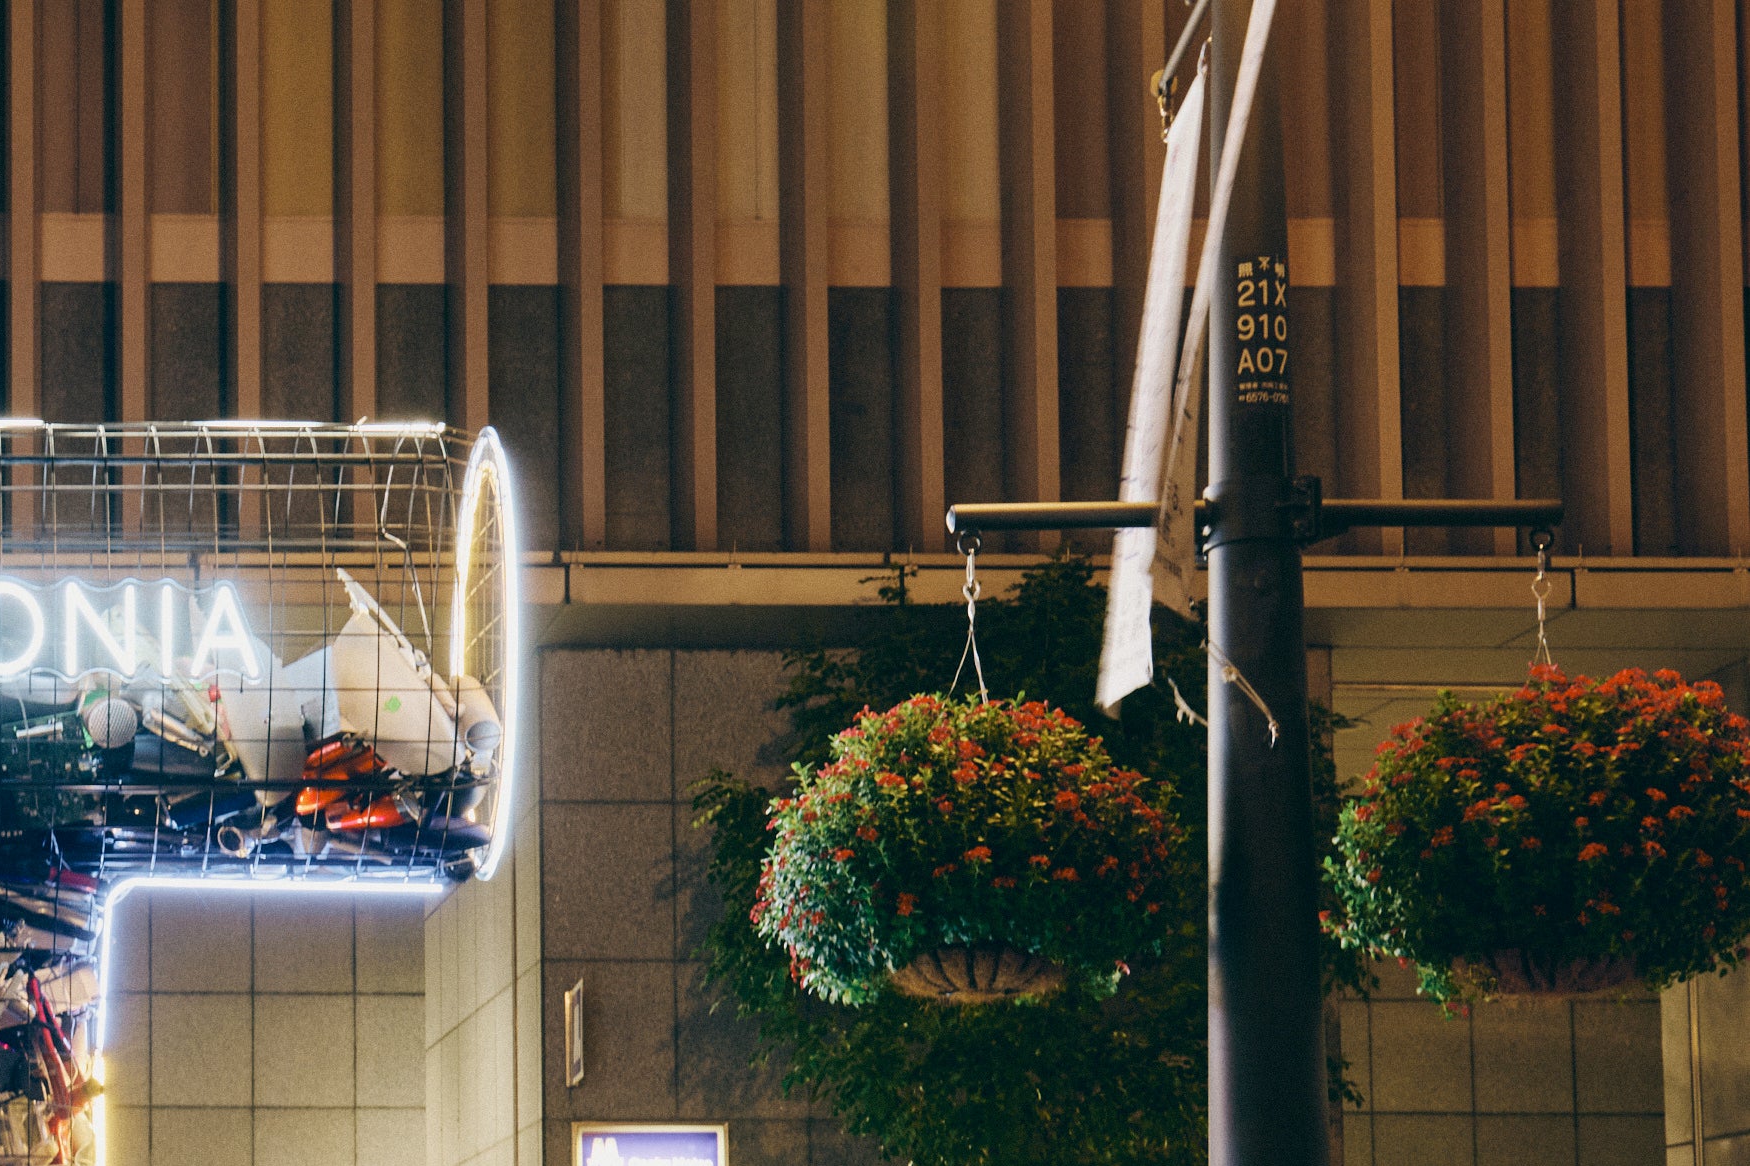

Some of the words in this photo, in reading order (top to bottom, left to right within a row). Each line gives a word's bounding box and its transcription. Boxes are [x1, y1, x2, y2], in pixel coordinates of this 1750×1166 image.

[1237, 279, 1287, 308] 21X
[1237, 313, 1287, 342] 910
[1237, 347, 1288, 376] A07
